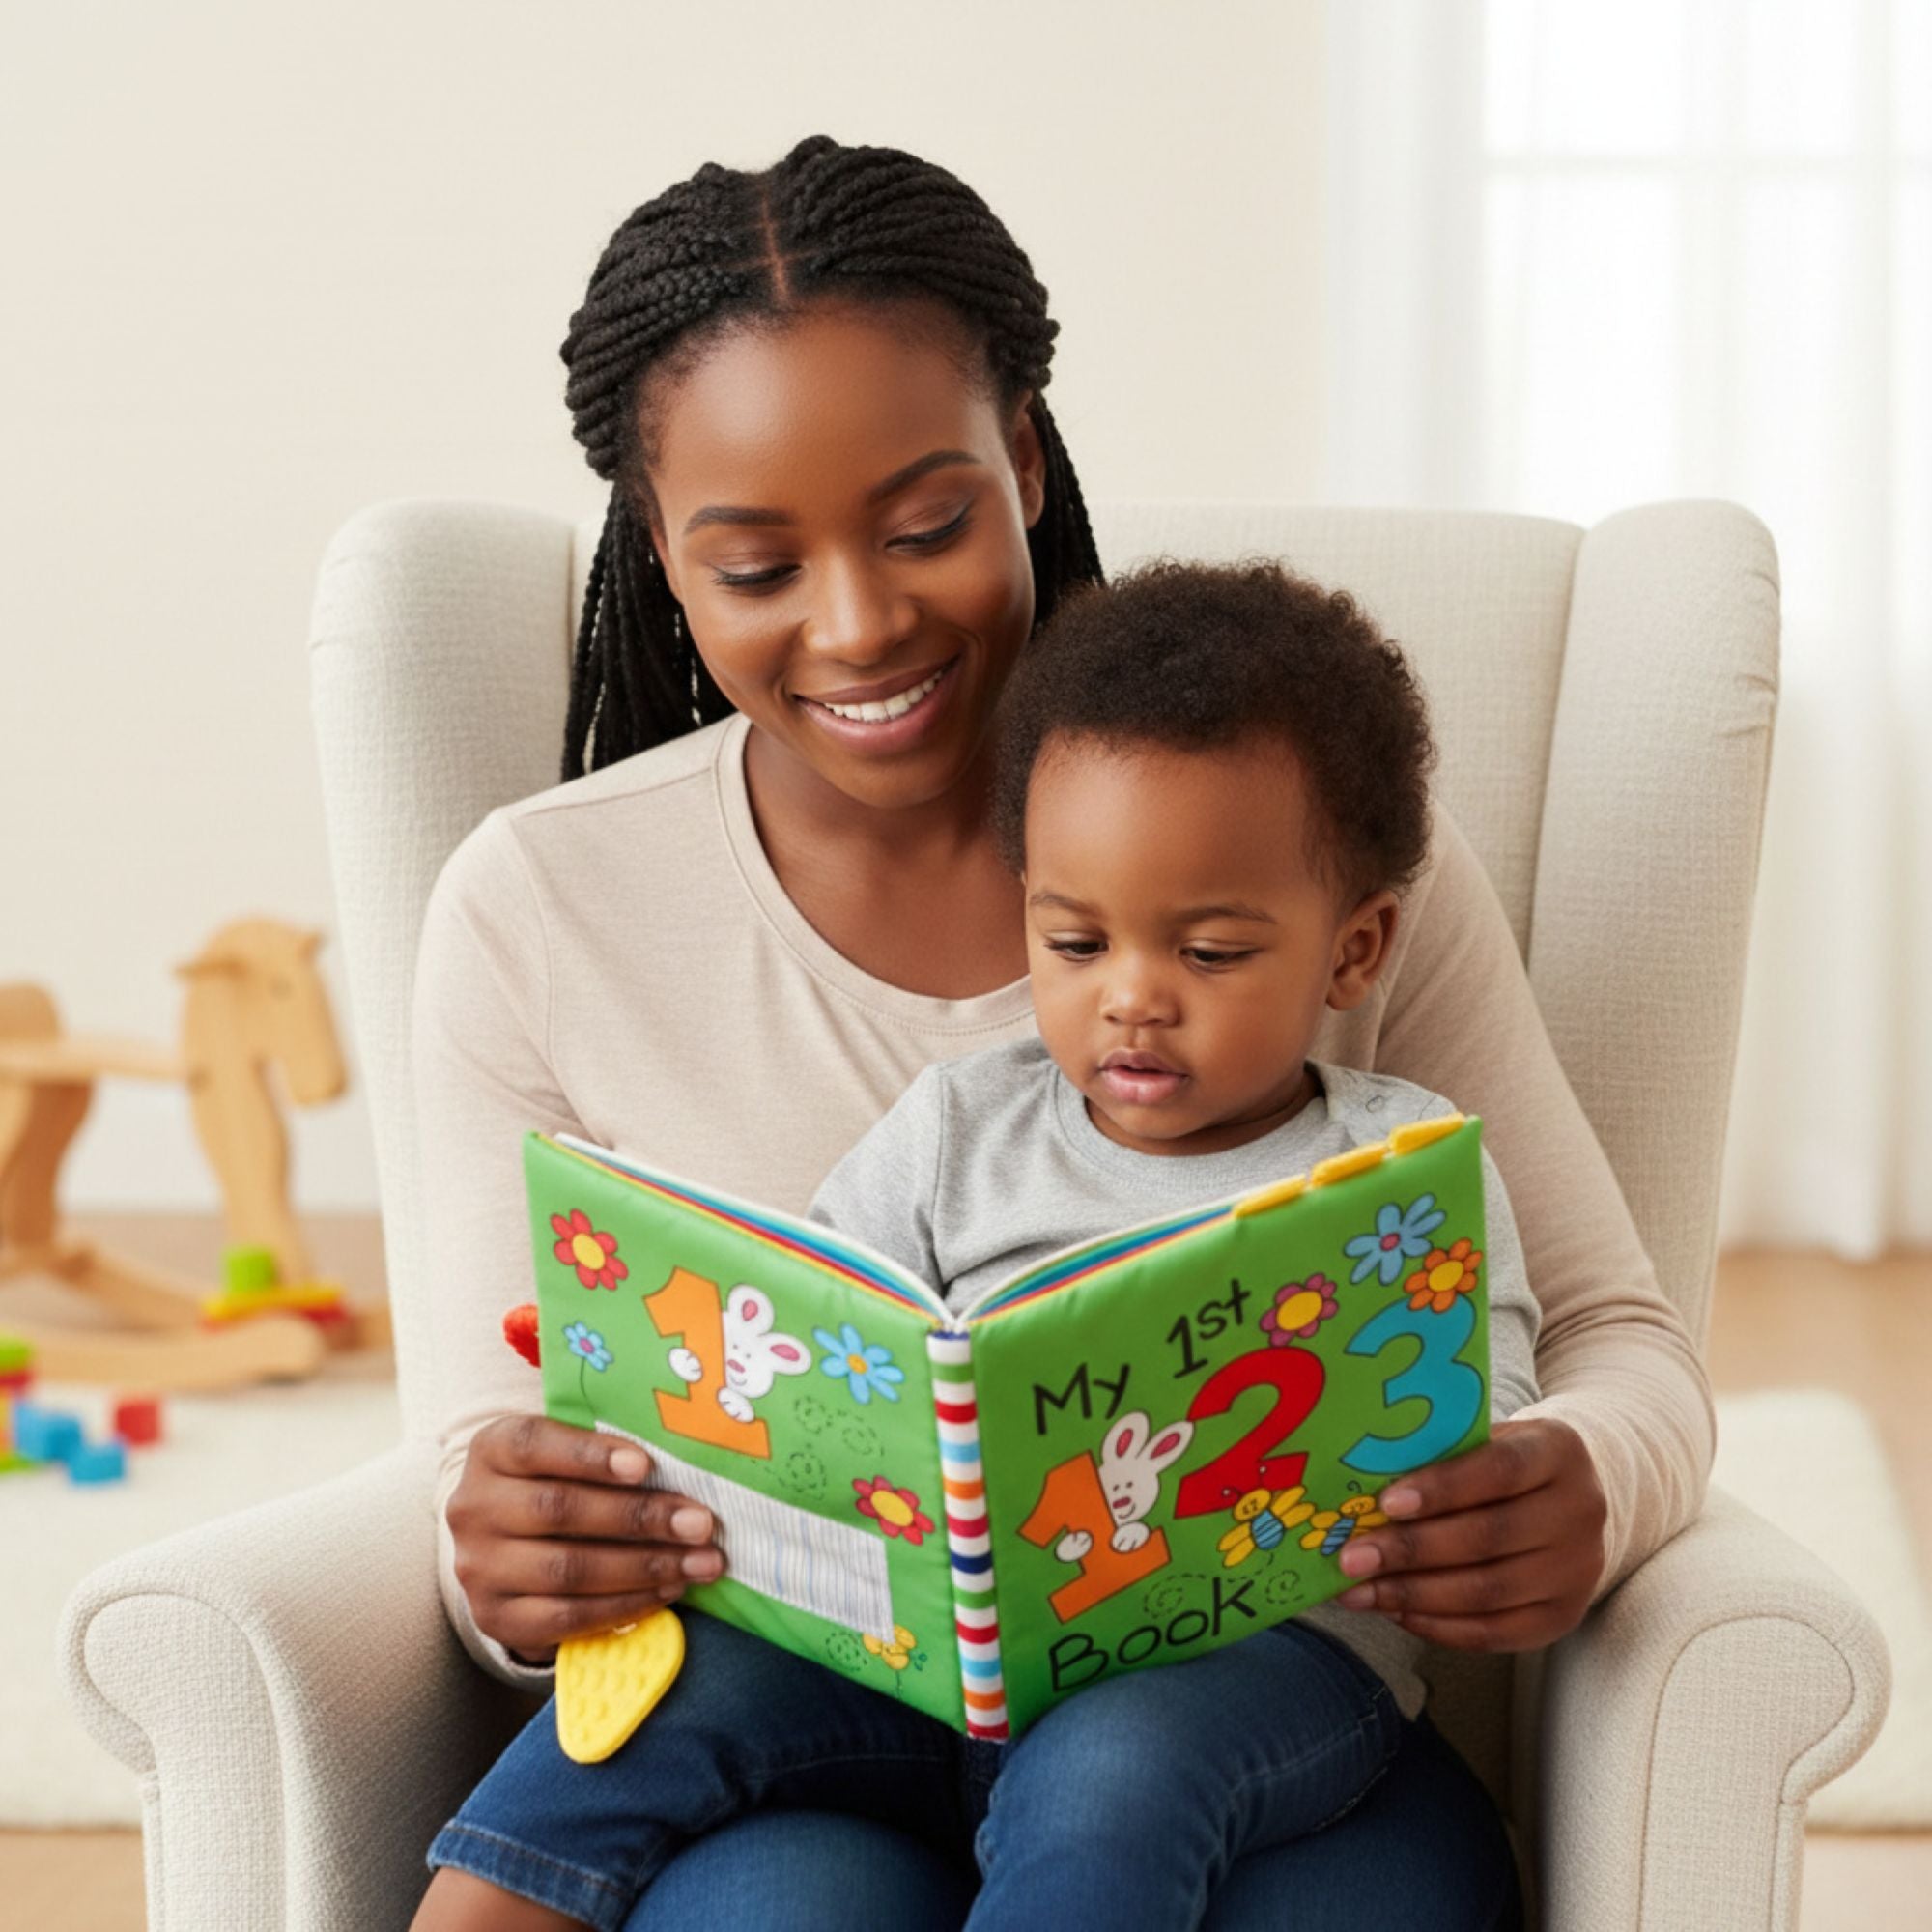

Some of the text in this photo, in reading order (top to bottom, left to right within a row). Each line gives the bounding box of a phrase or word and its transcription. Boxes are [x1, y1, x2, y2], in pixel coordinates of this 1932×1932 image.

[644, 1266, 771, 1459] 1
[1031, 1278, 1252, 1435] My 1st
[1017, 1293, 1483, 1623] 1 2 3
[1048, 1576, 1259, 1693] Book
